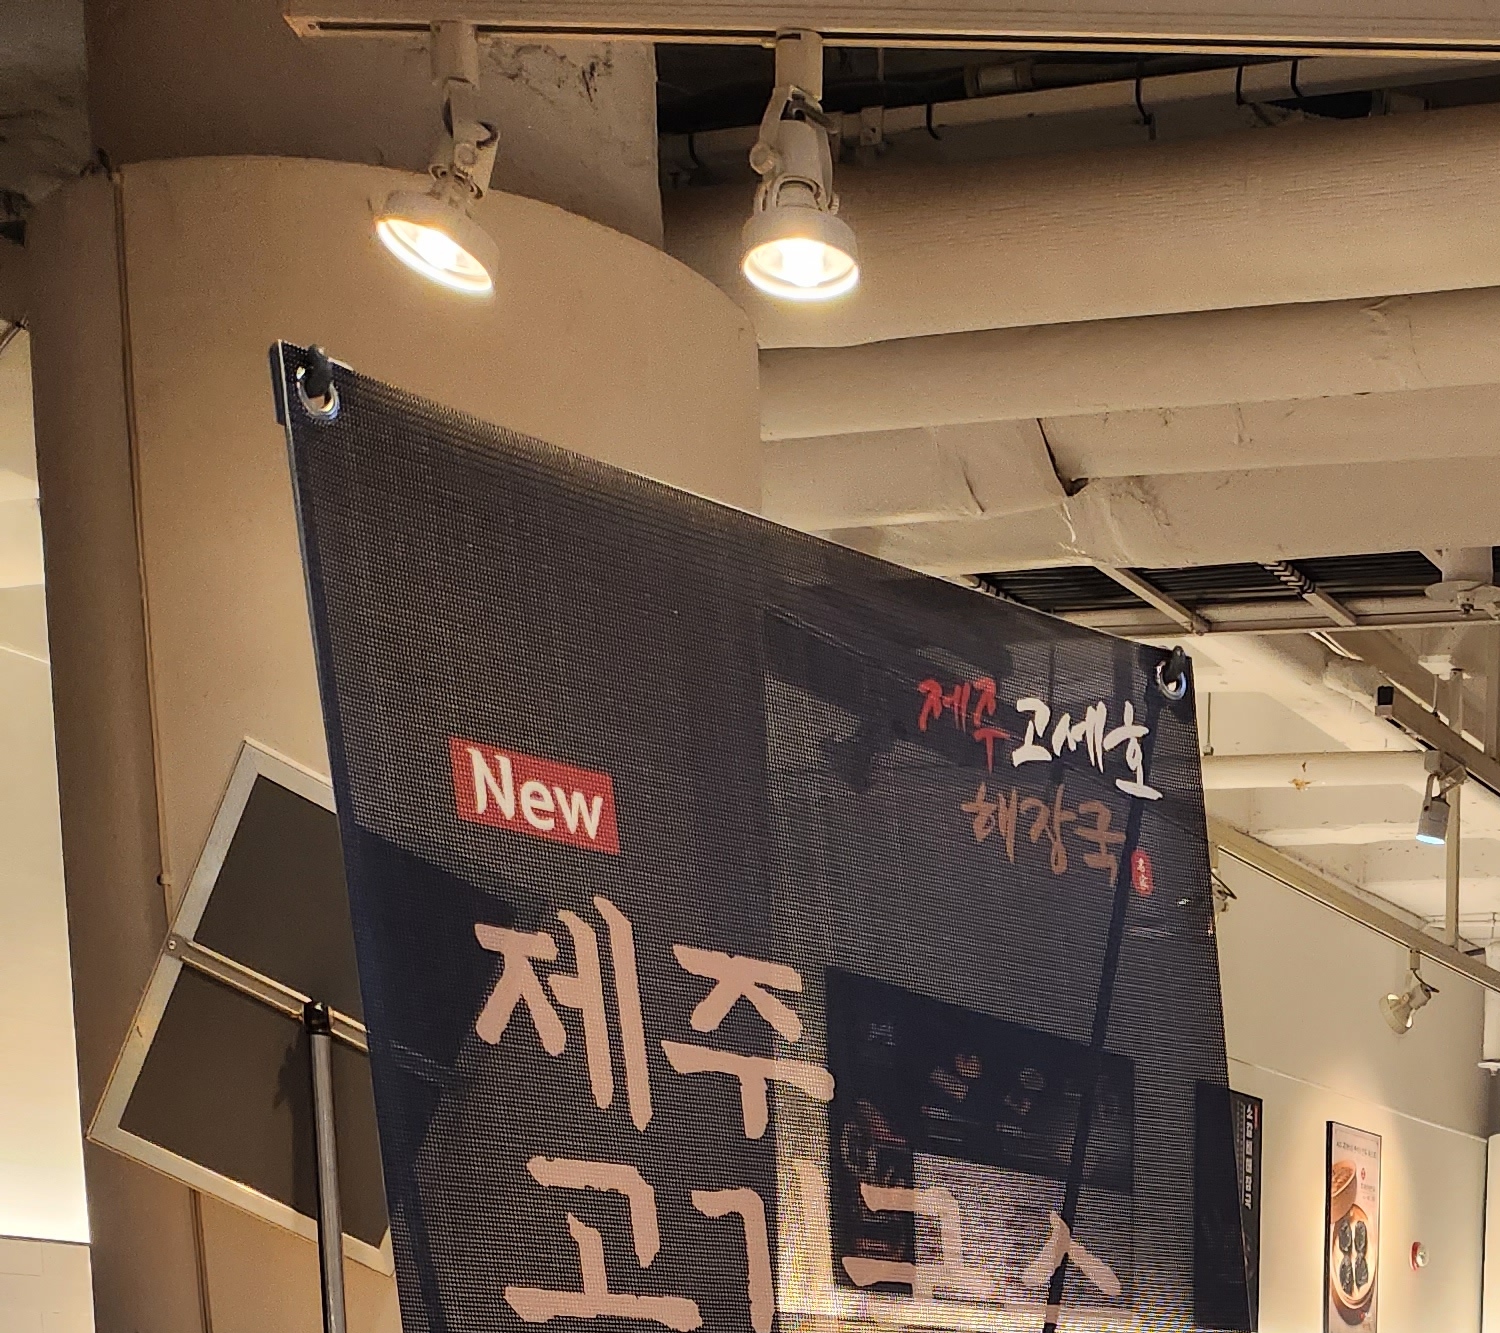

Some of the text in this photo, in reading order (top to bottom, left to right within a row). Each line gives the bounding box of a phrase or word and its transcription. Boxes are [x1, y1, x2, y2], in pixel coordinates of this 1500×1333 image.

[469, 744, 603, 840] New
[918, 676, 1163, 800] 제주 고세호
[961, 782, 1126, 887] 해장국
[475, 896, 836, 1132] 제주
